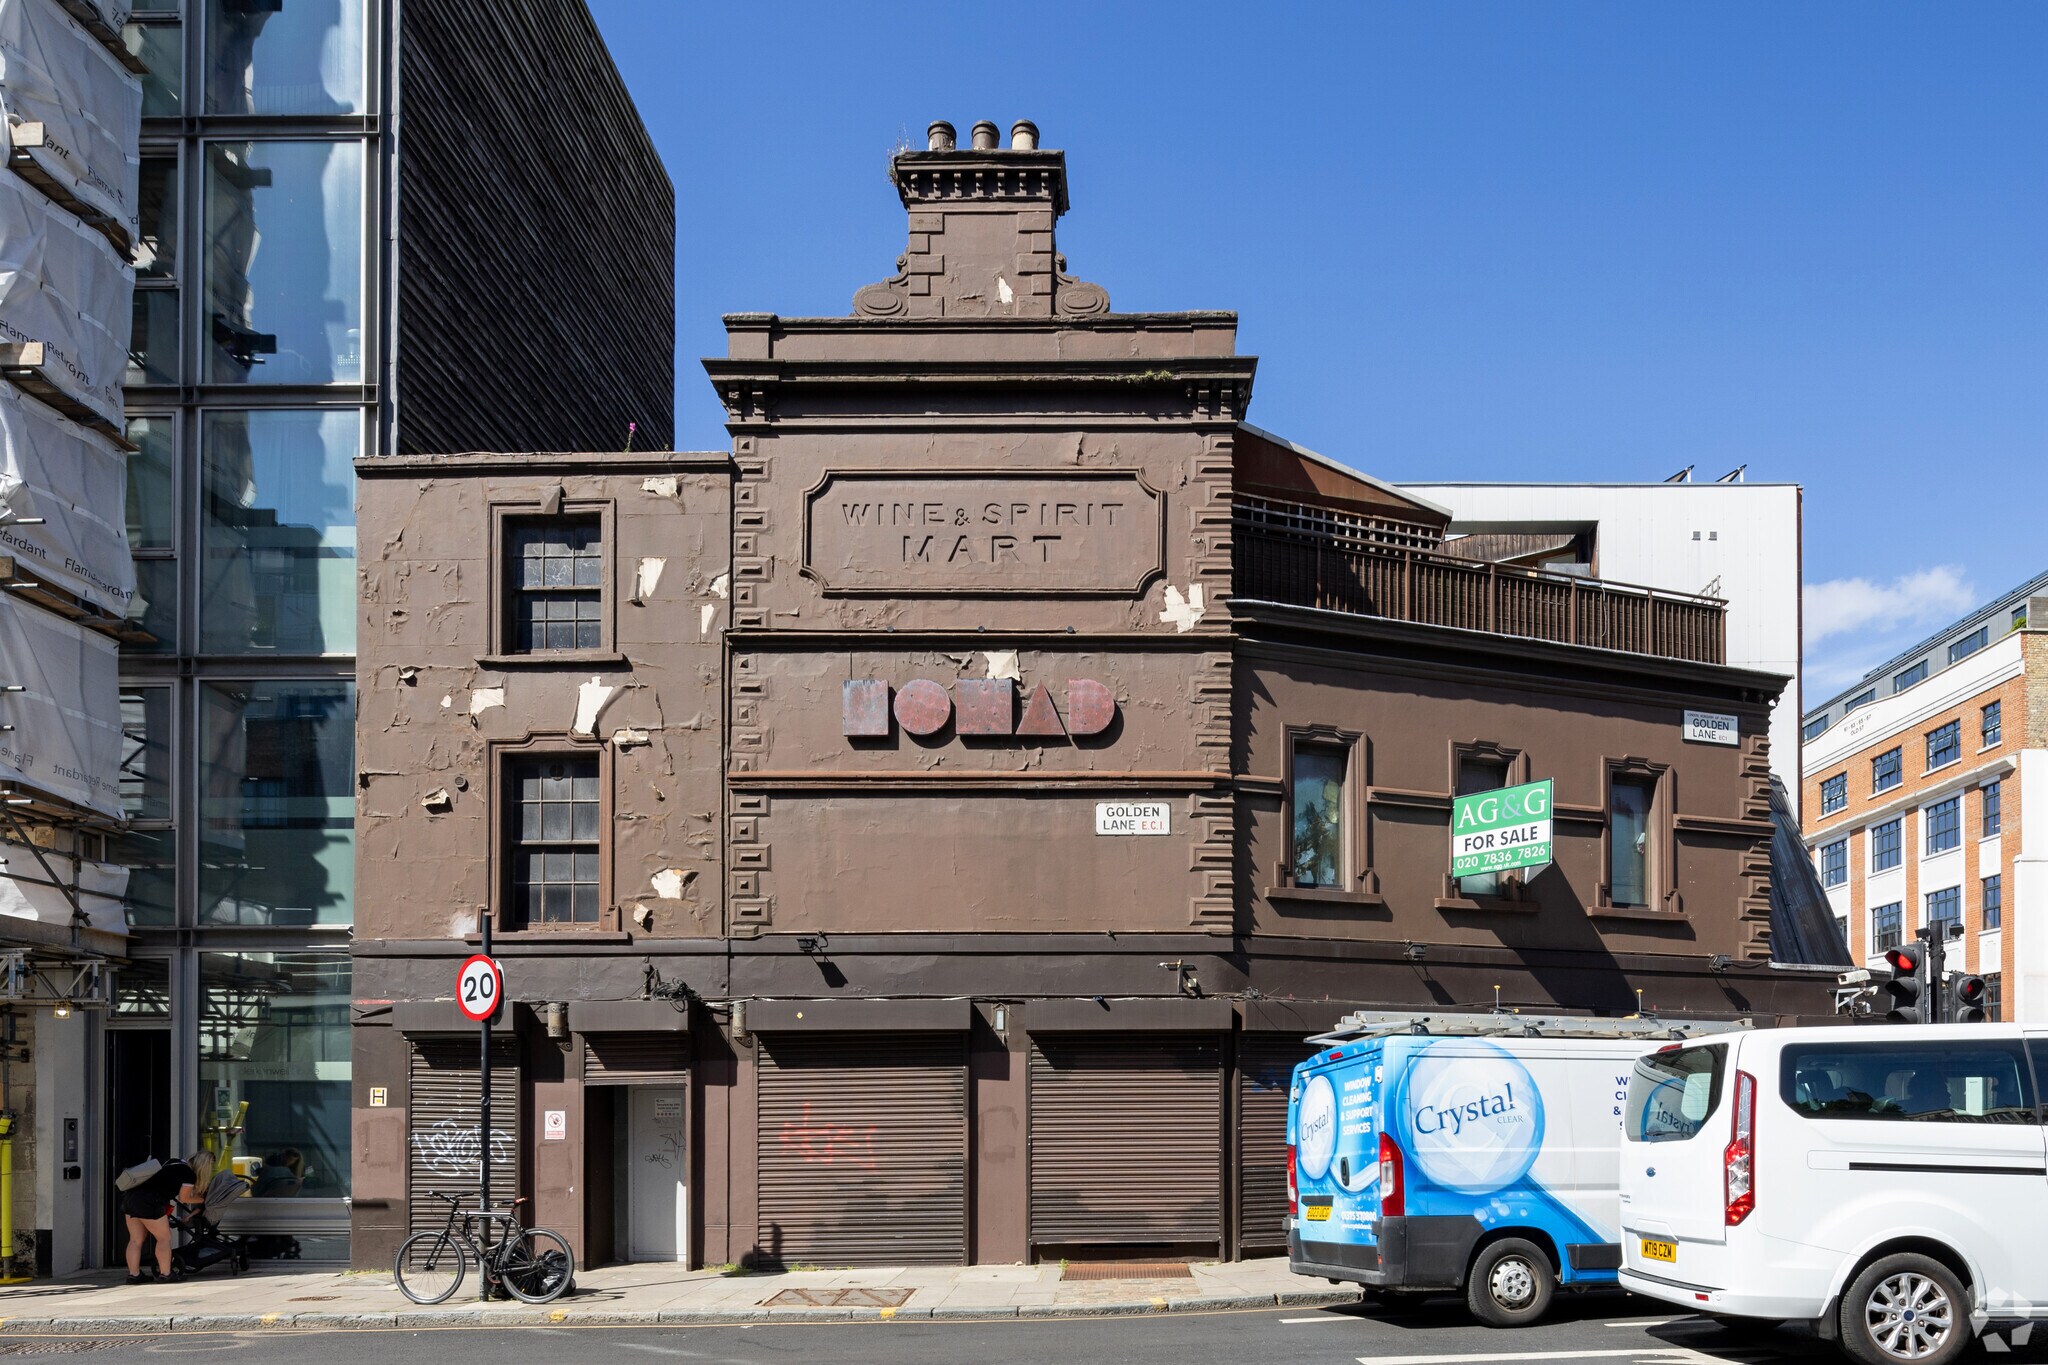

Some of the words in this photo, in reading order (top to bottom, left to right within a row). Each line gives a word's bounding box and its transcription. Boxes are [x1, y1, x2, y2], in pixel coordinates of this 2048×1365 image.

[842, 503, 945, 527] WINE
[982, 503, 1124, 527] SPIRIT
[902, 535, 1062, 563] MART
[1693, 718, 1729, 730] GOLDEN
[1692, 728, 1716, 740] LANE
[1106, 806, 1160, 817] GOLDEN
[1457, 788, 1547, 829] AG&G
[1103, 820, 1136, 830] LANE
[1464, 834, 1495, 852] FOR
[1500, 826, 1538, 846] SALE
[1457, 856, 1479, 869] 020
[1484, 851, 1512, 865] 7836
[1518, 845, 1546, 860] 7826
[464, 972, 494, 1003] 20
[1344, 1076, 1372, 1092] WINDOW
[372, 1089, 385, 1105] H
[1342, 1091, 1372, 1107] CLEANING
[1345, 1106, 1373, 1120] SUPPORT
[1415, 1082, 1516, 1135] Crystal
[1301, 1105, 1329, 1141] Crystal
[1497, 1115, 1524, 1125] CLEAR
[1342, 1122, 1371, 1136] SERVICES
